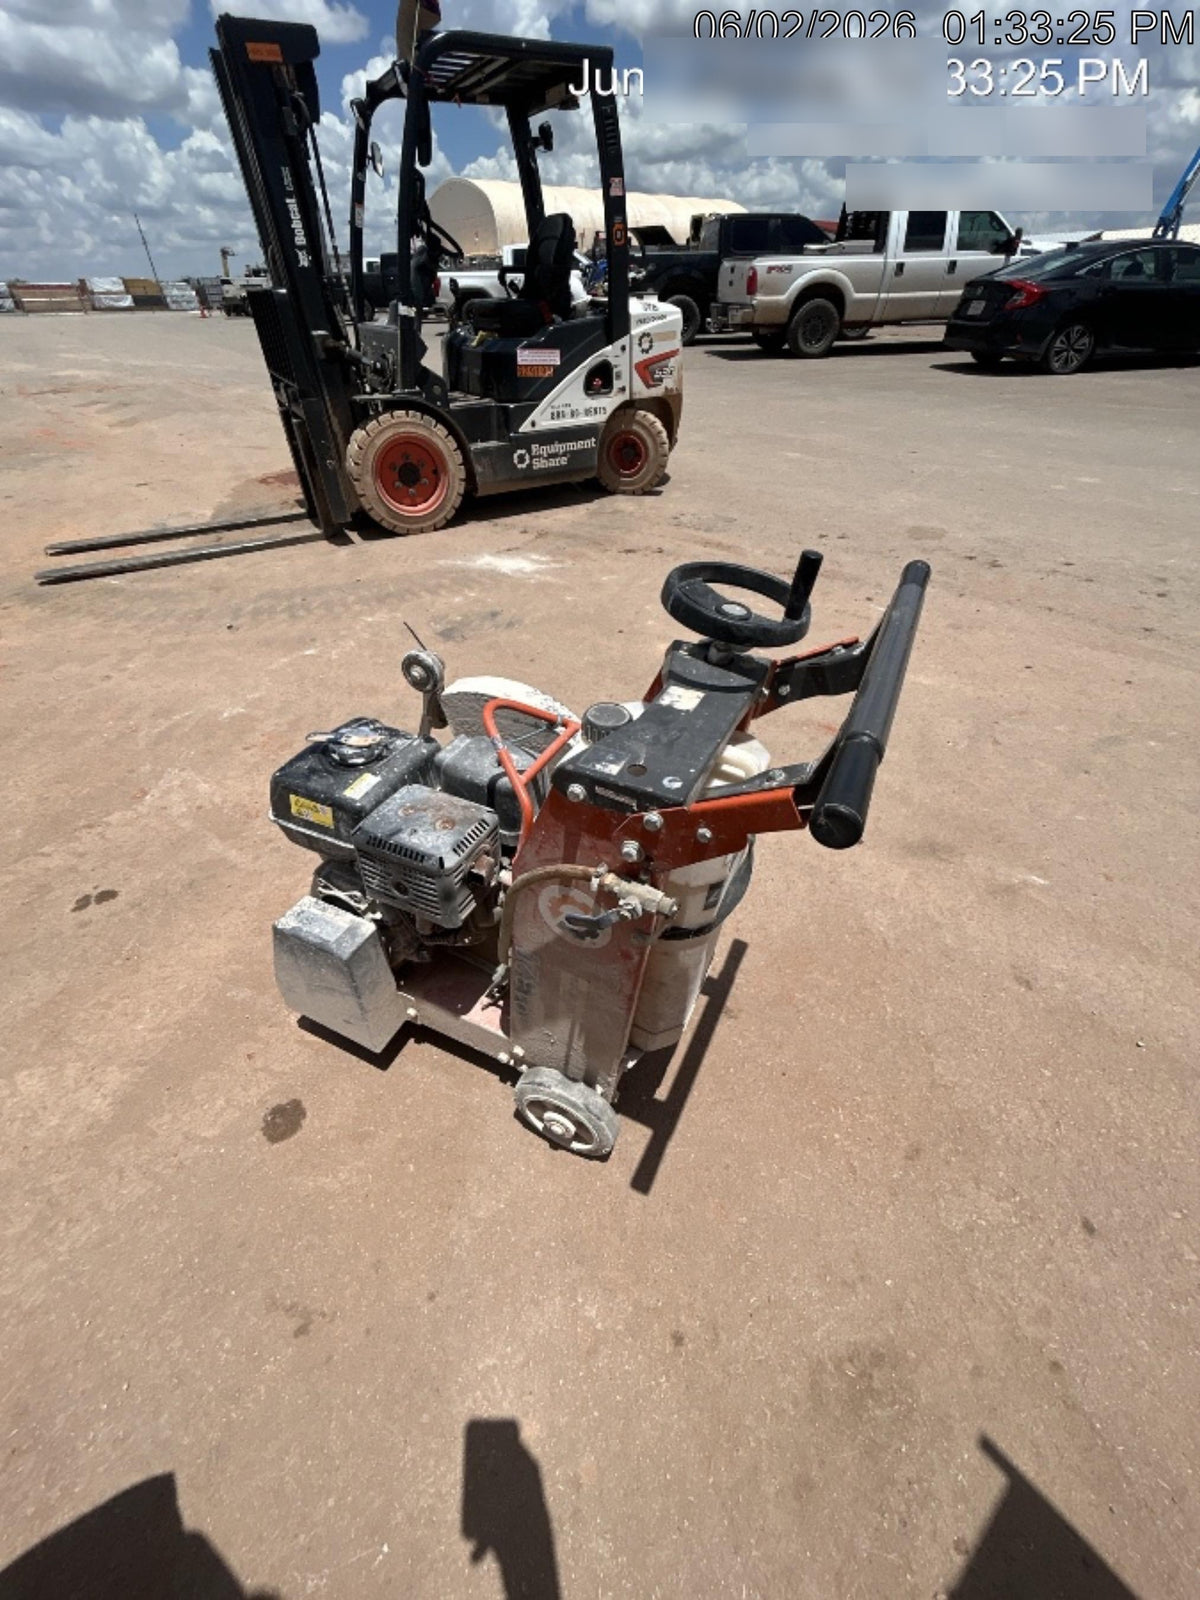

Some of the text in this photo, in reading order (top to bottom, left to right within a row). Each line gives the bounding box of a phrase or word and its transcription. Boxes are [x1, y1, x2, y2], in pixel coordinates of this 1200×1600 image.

[285, 195, 307, 246] Bobcat
[531, 437, 597, 457] Equipment
[532, 456, 568, 470] Share
